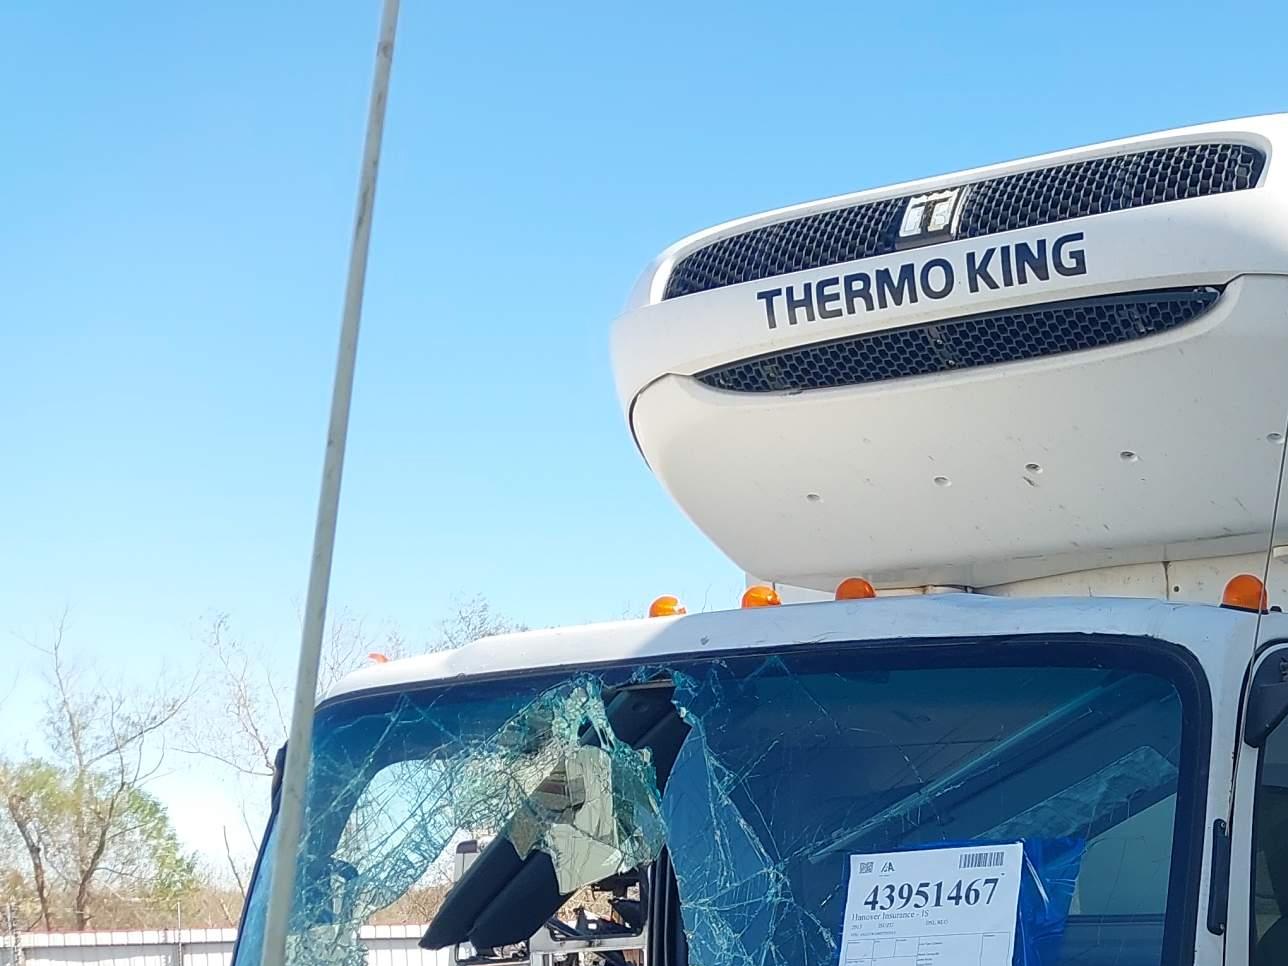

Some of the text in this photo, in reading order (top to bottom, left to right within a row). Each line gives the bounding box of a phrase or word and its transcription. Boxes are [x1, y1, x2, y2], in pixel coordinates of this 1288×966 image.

[756, 231, 1088, 330] THERMO KING
[864, 878, 1000, 911] 43951467
[882, 911, 915, 920] Insurance
